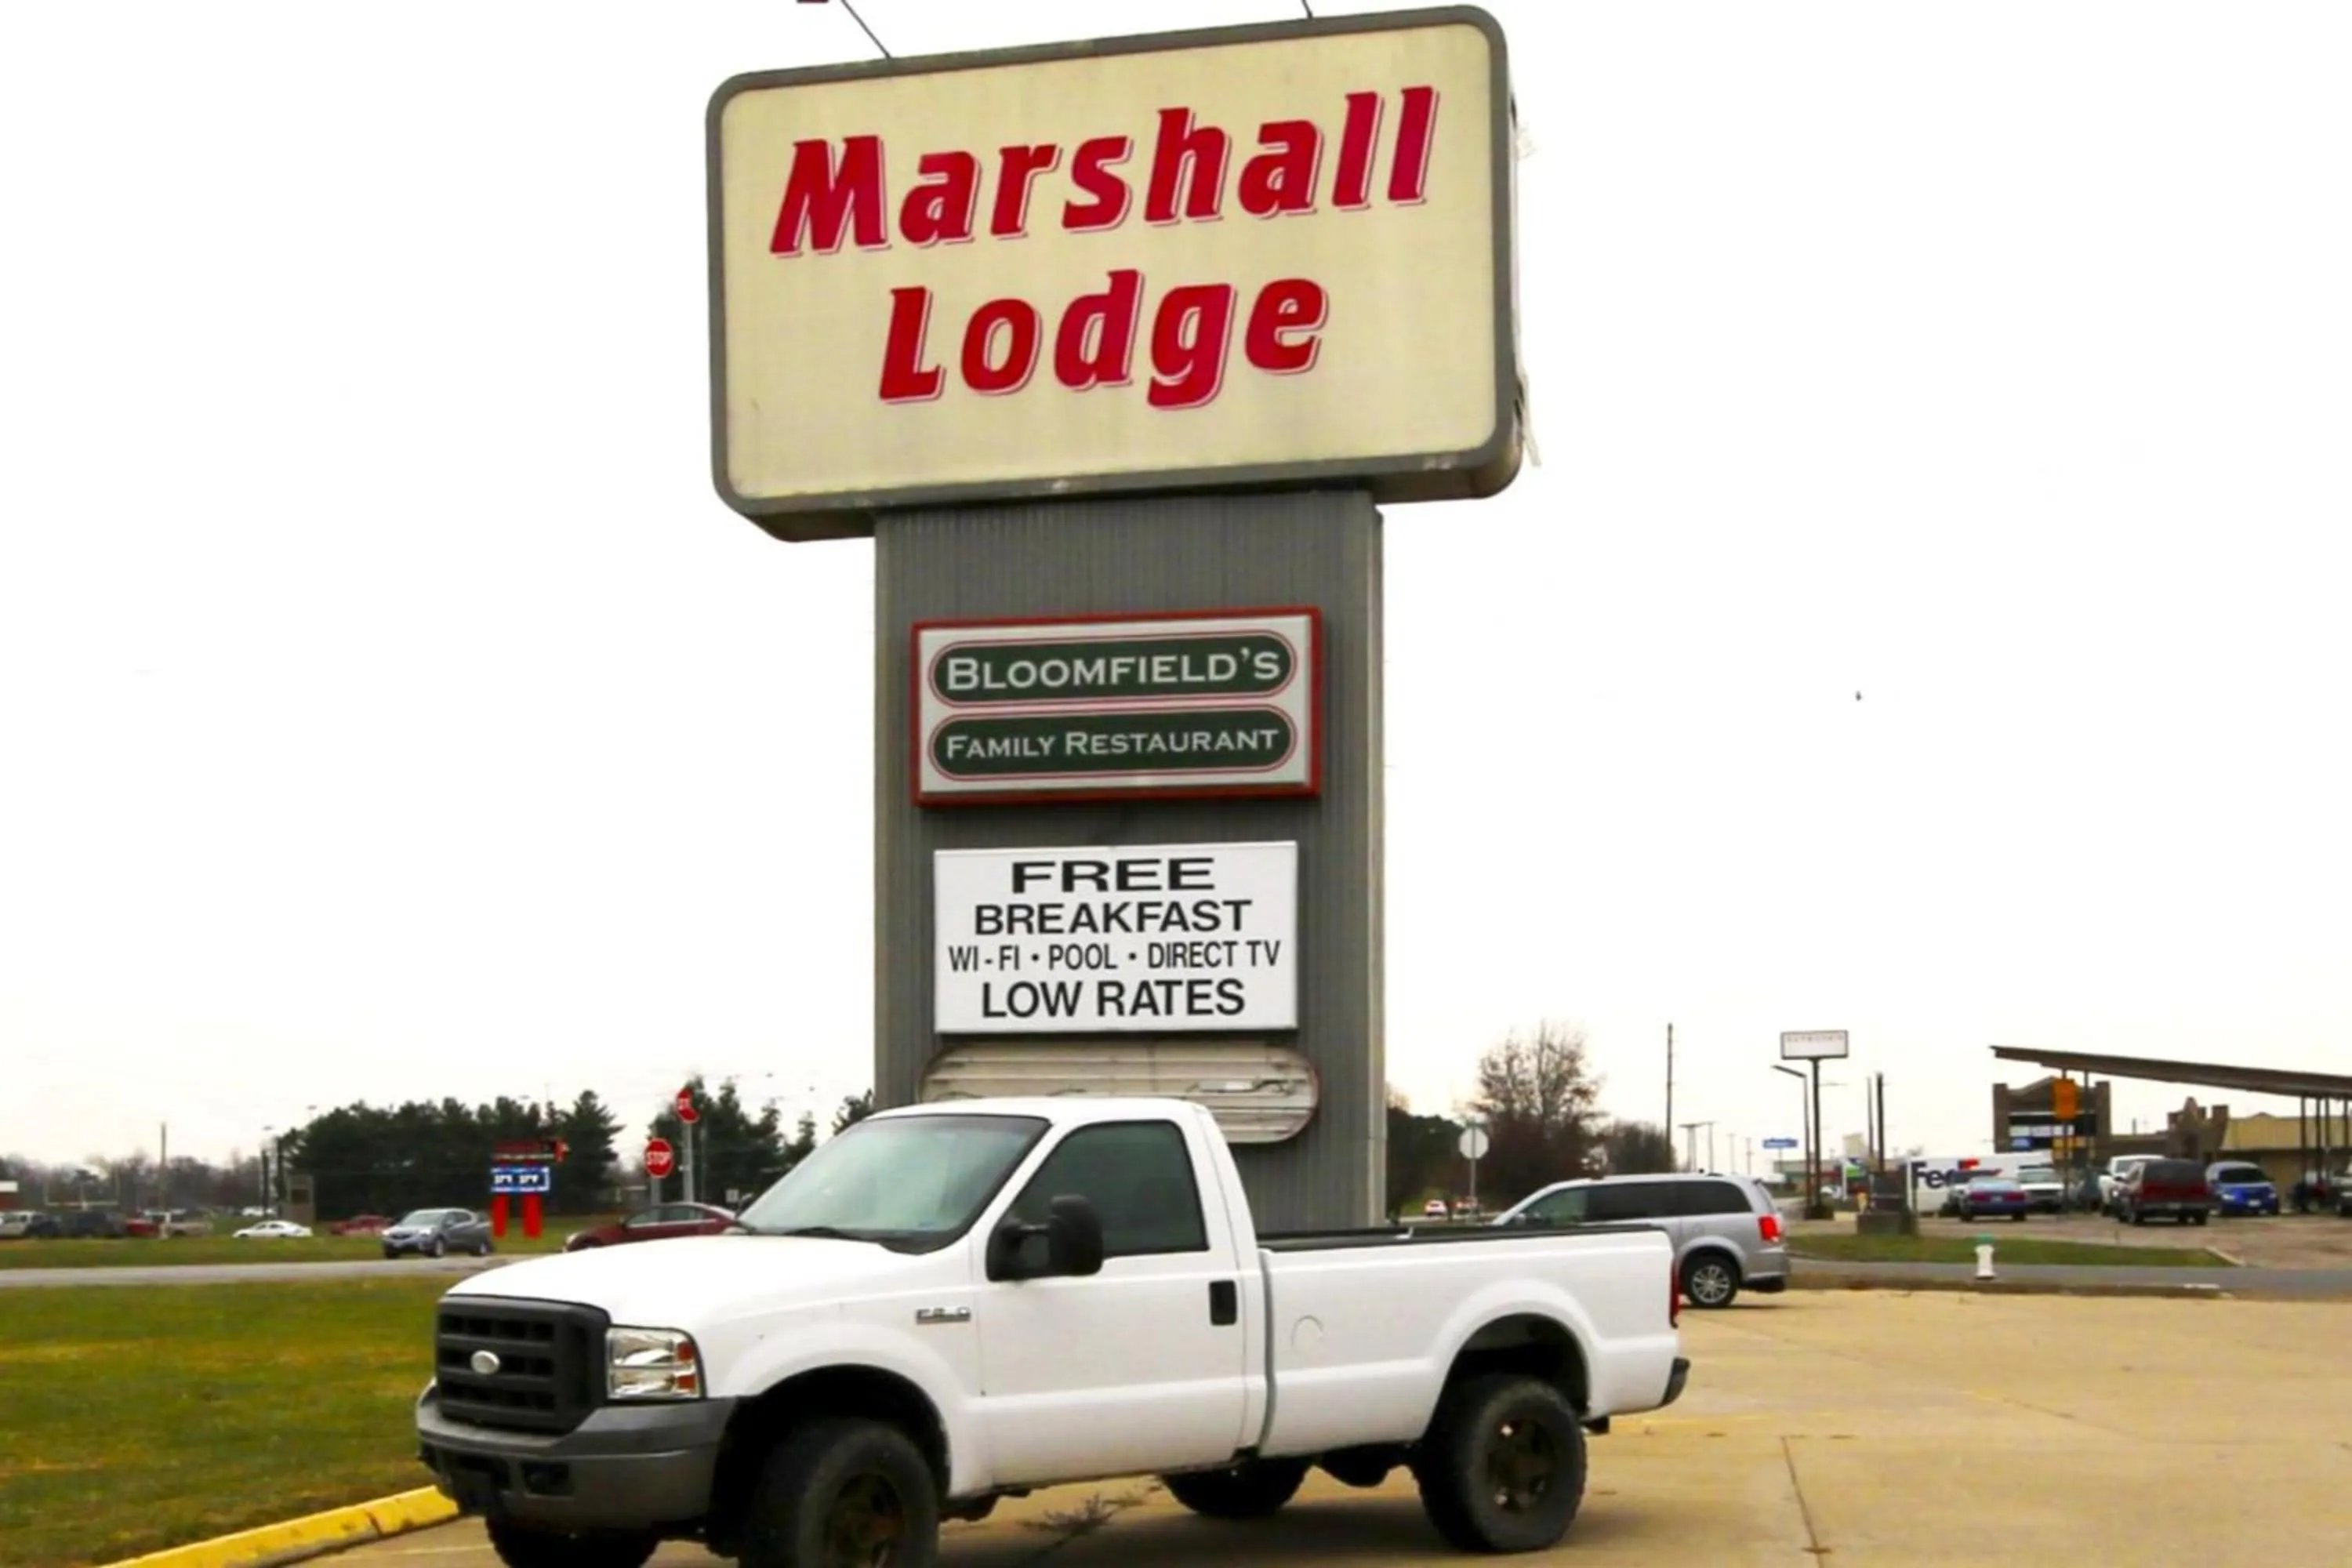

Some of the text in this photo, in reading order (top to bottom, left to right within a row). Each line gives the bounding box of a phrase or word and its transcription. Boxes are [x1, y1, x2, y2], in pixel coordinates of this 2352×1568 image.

[769, 84, 1438, 258] Marshall
[878, 267, 1328, 412] Lodge
[946, 647, 1281, 691] BLOOMFIELD'S
[946, 728, 1279, 760] FAMILY RESTAURANT
[1011, 857, 1214, 894] FREE
[975, 899, 1253, 935] BREAKFAST
[1048, 943, 1118, 971] POOL
[1147, 940, 1239, 969] DIRECT
[1246, 938, 1281, 967] TV
[982, 977, 1246, 1018] LOW RATES
[647, 1150, 670, 1165] STOP
